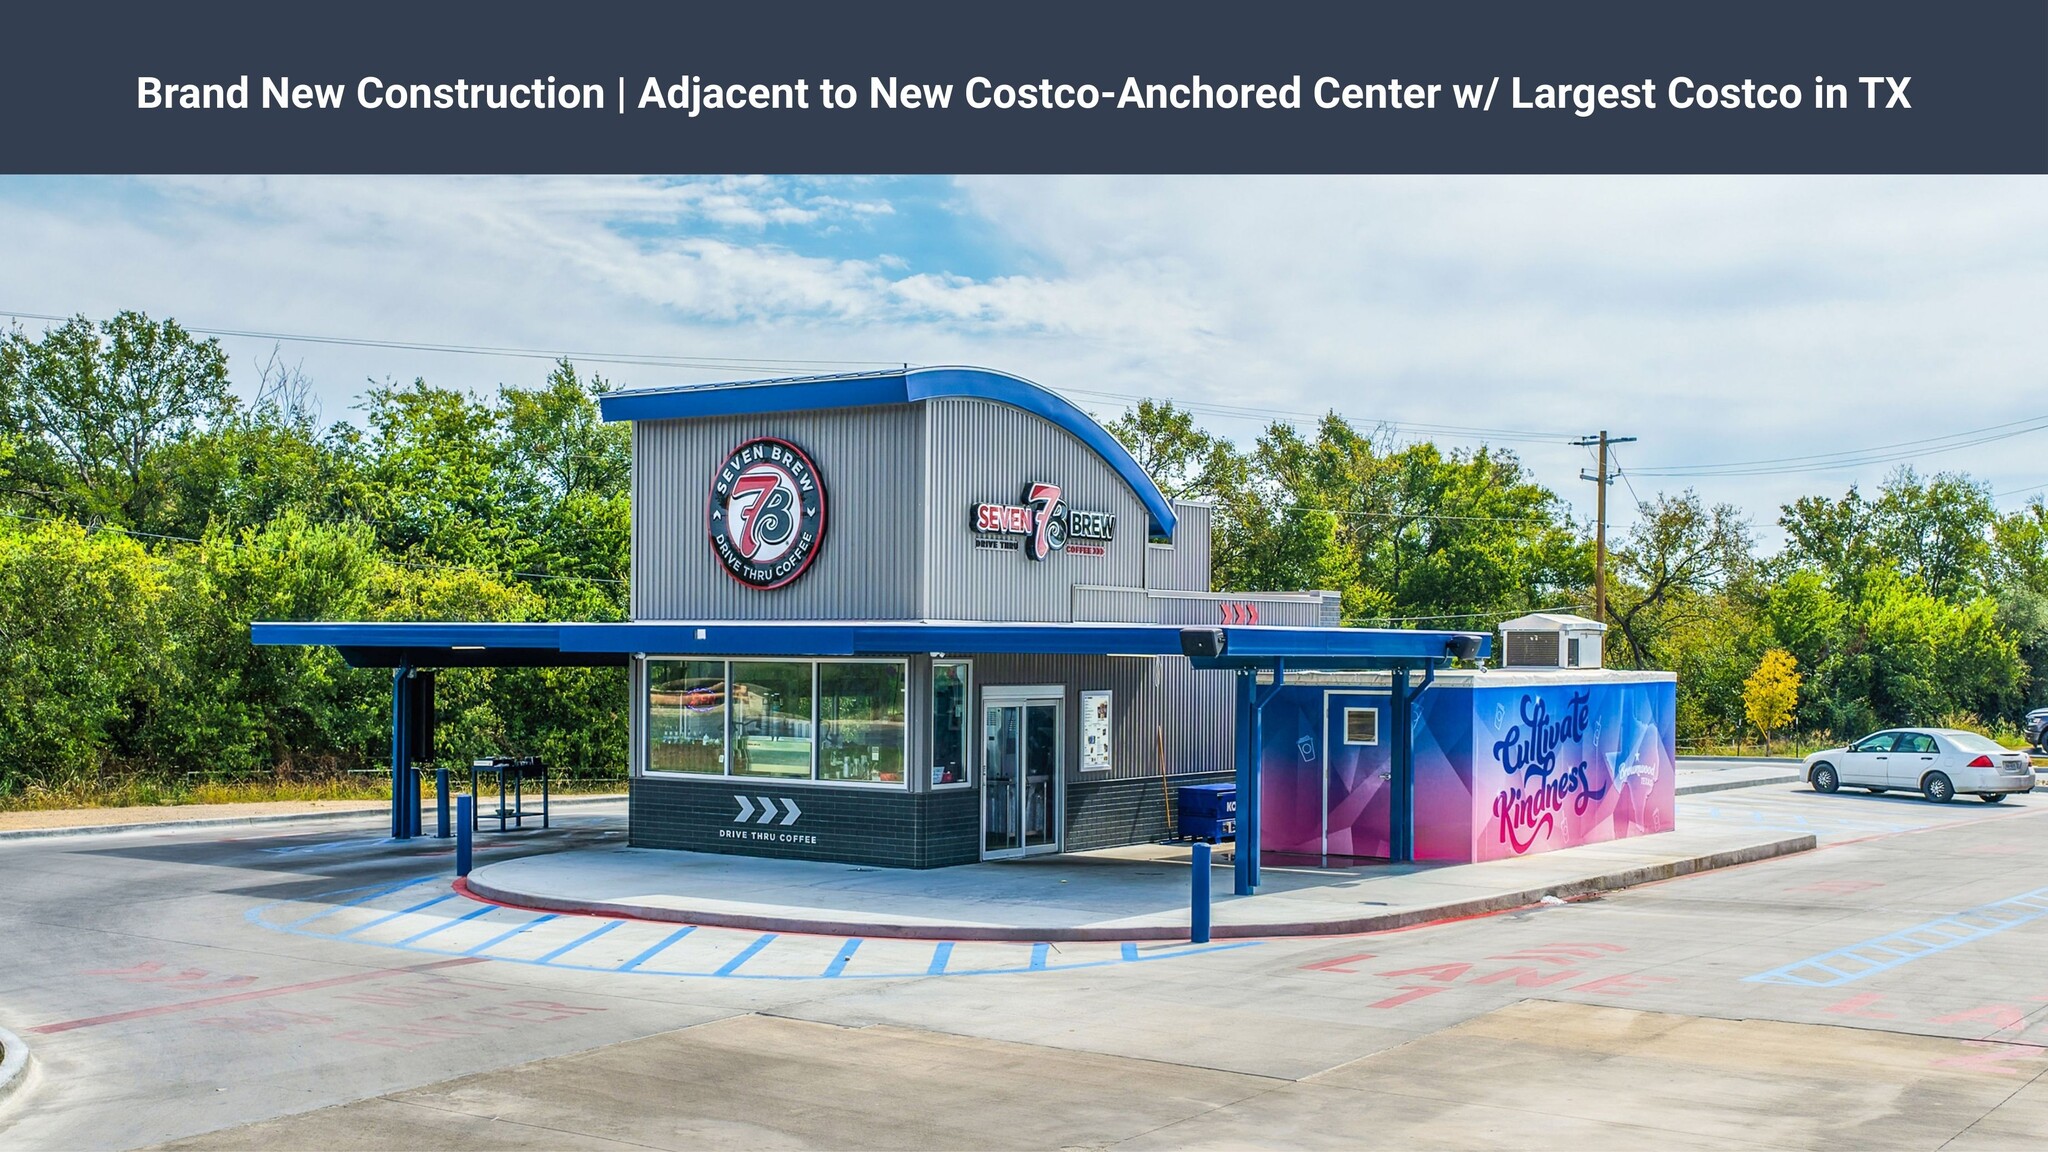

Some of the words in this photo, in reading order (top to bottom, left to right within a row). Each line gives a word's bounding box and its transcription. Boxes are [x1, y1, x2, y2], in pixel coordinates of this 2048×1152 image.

[717, 446, 764, 495] SEVEN
[771, 446, 814, 492] BREW
[978, 504, 1033, 534] SEVEN
[1070, 511, 1116, 539] BREW
[716, 534, 741, 572] DRIVE
[743, 566, 773, 581] THRU
[776, 531, 812, 576] COFFEE
[975, 539, 998, 549] DRIVE
[1000, 540, 1019, 550] THRU
[1066, 545, 1093, 555] COFFEE
[1493, 688, 1591, 775] Cultivate
[1493, 761, 1607, 855] Kindness
[719, 829, 748, 839] DRIVE
[751, 831, 776, 841] THRU
[779, 833, 817, 844] COFFEE
[1297, 953, 1681, 996] LANE
